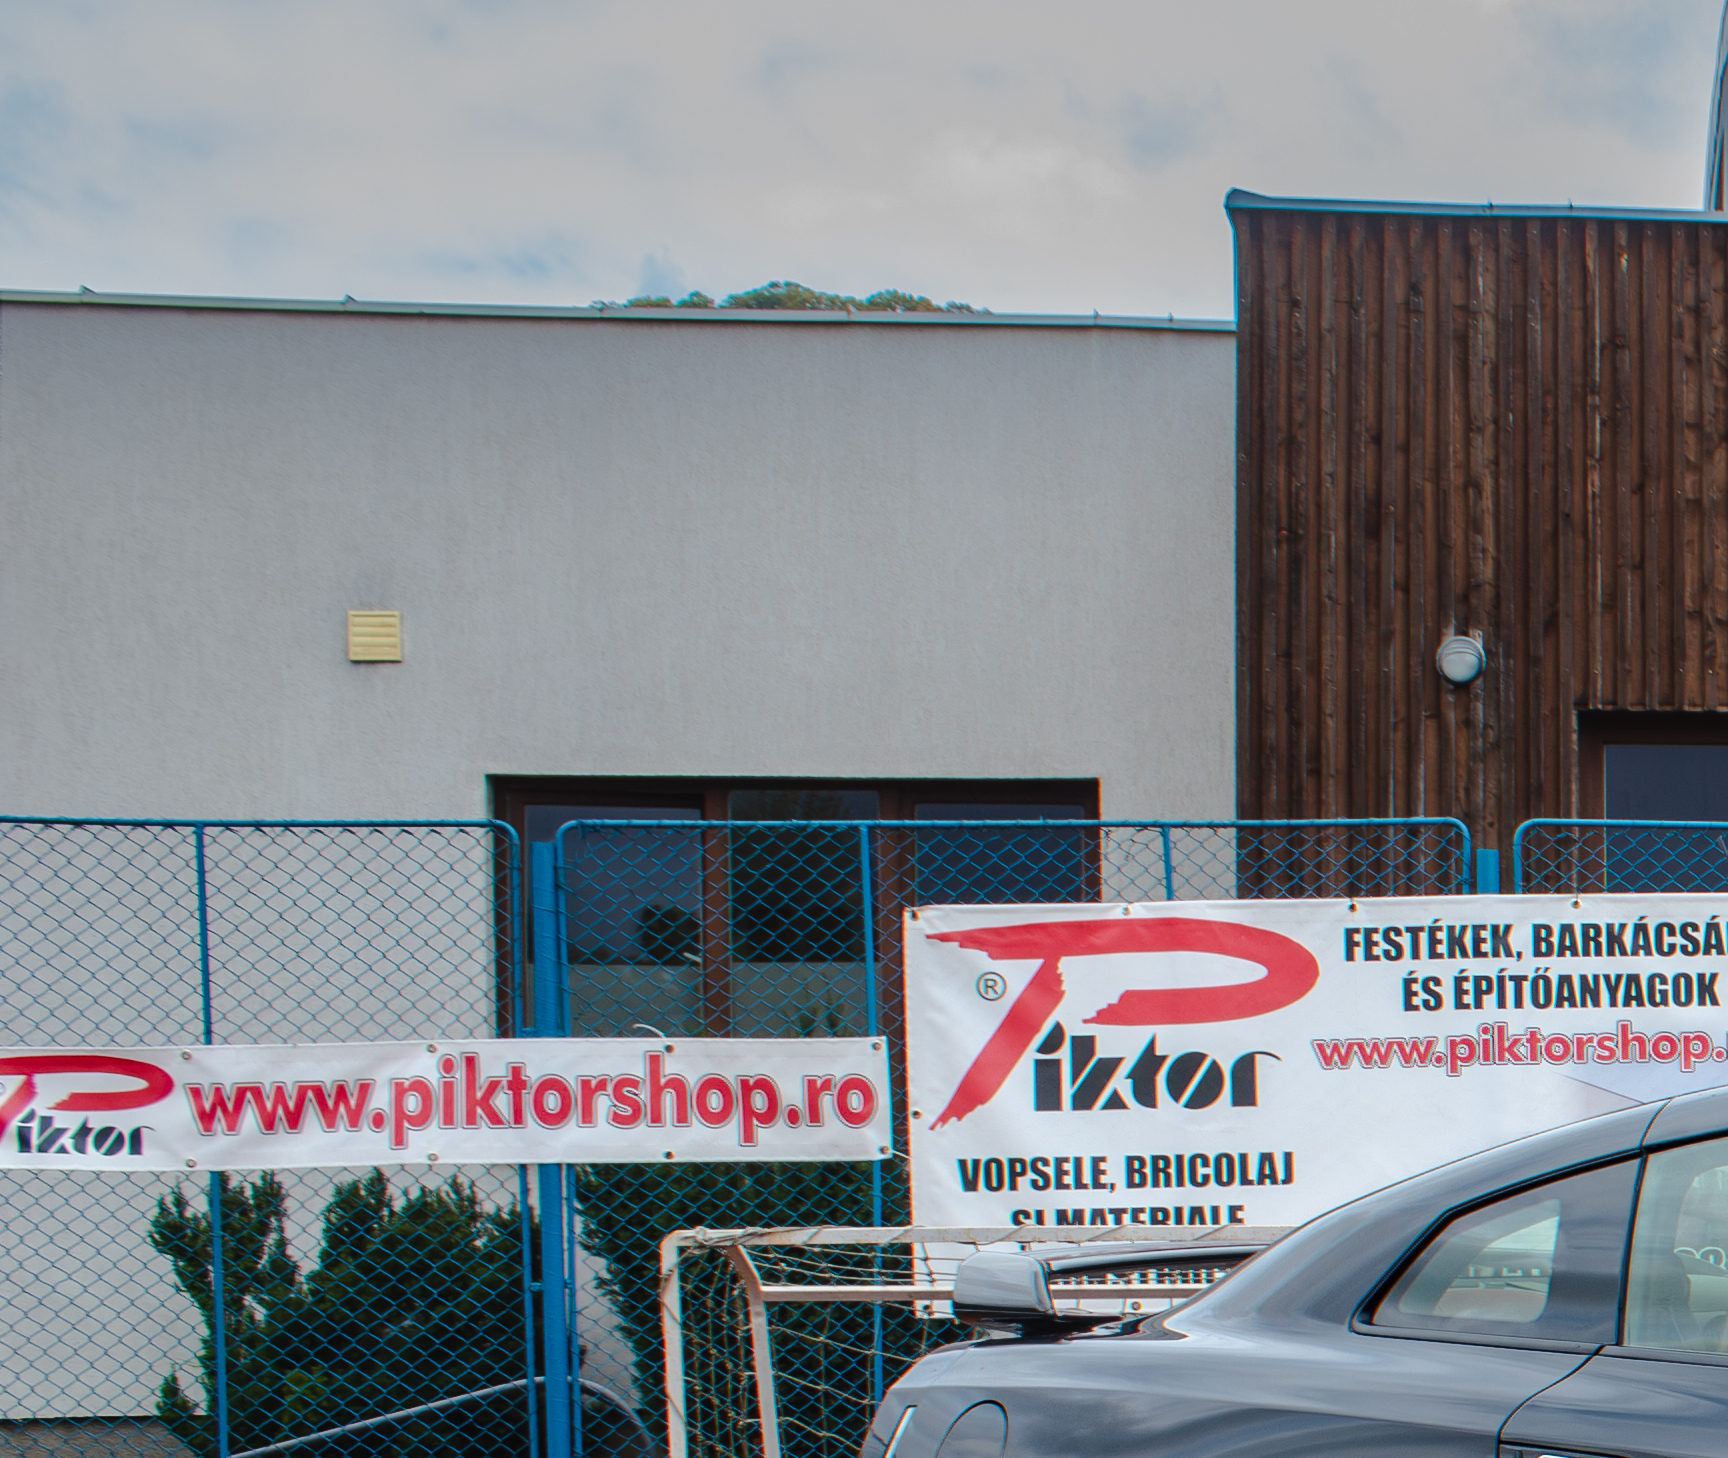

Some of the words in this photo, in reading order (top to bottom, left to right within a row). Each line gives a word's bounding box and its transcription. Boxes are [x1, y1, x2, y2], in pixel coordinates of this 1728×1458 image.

[1344, 918, 1524, 962] FESTÉKEK,
[1402, 969, 1443, 1012] ÉS
[1453, 966, 1721, 1010] ÉPÍTŐANYAGOK
[184, 1050, 880, 1150] www.piktorshop.ro
[957, 1154, 1117, 1193] VOPSELE,
[1125, 1151, 1295, 1190] BRICOLAJ
